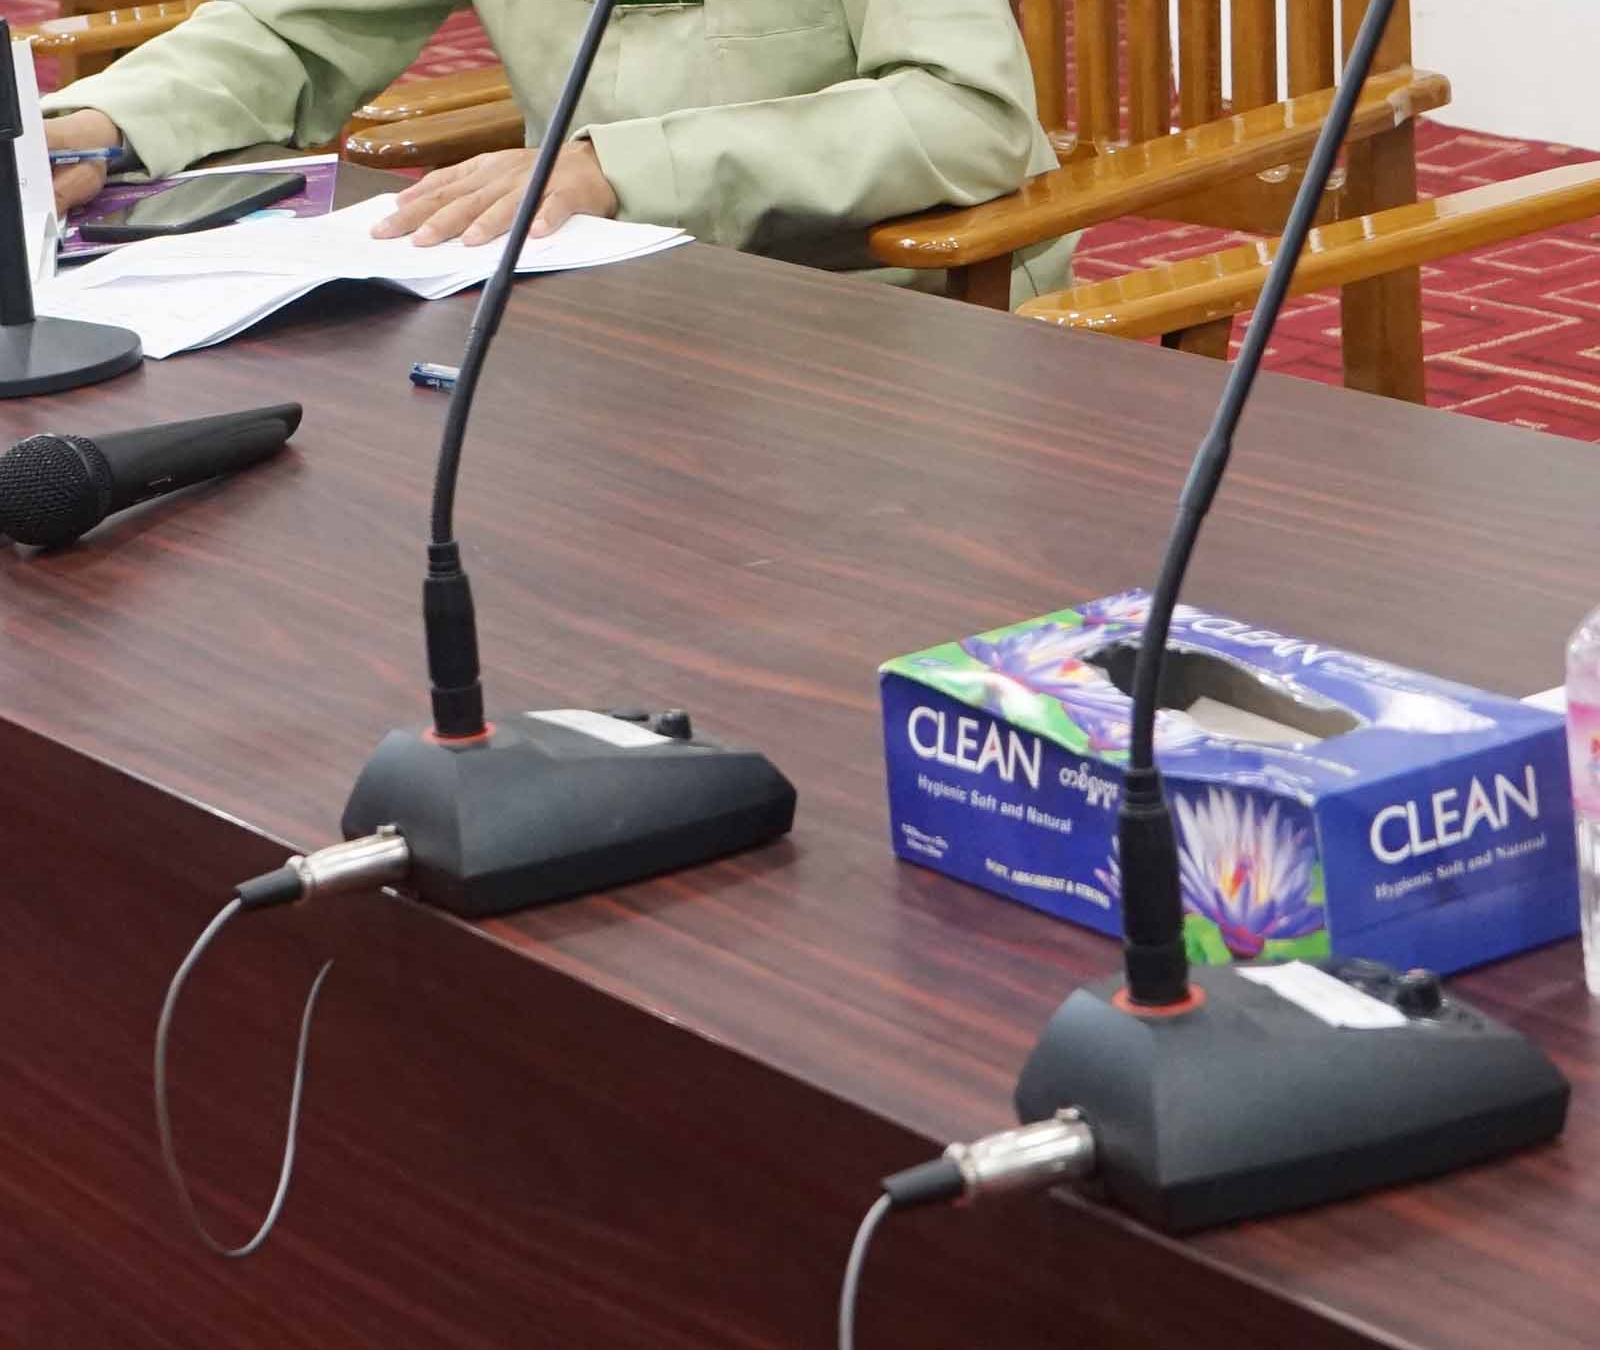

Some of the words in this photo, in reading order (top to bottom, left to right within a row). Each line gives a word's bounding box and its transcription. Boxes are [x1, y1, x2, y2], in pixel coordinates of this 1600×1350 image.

[1190, 617, 1345, 666] CLEAN
[908, 706, 1041, 789] CLEAN
[917, 773, 967, 803] Hygienic
[970, 789, 997, 811] Soft
[1000, 800, 1024, 819] and
[1026, 804, 1072, 834] Natural
[1369, 764, 1539, 865] CLEAN
[1375, 871, 1433, 900] Hygienic
[1436, 860, 1466, 879] Soft
[1467, 851, 1493, 872] and
[1496, 832, 1547, 859] Natural
